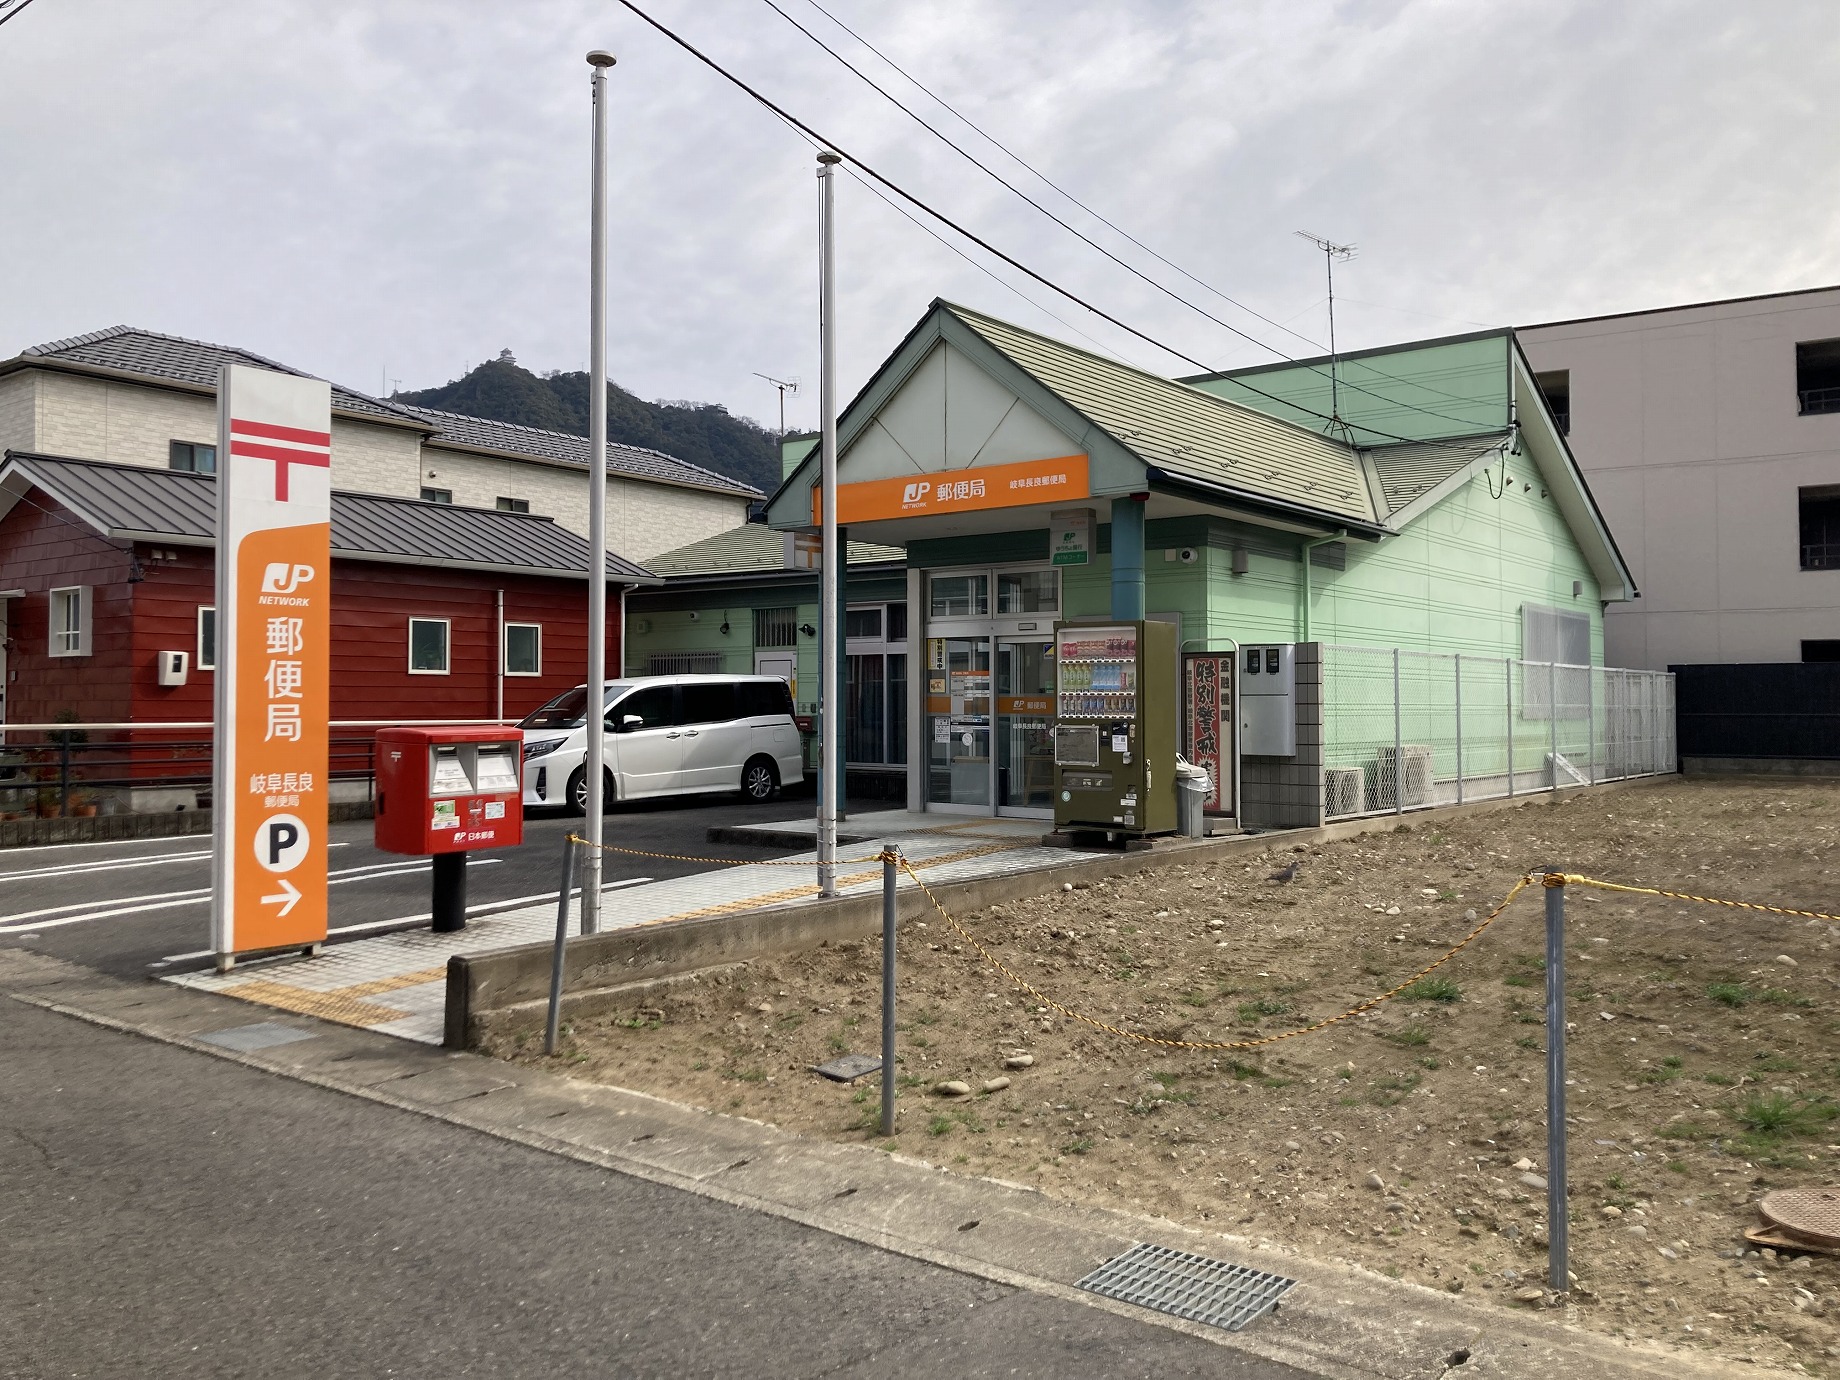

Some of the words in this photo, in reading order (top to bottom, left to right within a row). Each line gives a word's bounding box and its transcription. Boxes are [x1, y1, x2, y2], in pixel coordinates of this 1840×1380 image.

[936, 479, 986, 502] 郵便局
[1009, 474, 1067, 490] 岐阜長良郵便局
[901, 502, 927, 510] NETWORK
[258, 595, 310, 607] NETWORK
[264, 616, 304, 743] 郵便局
[1220, 659, 1230, 722] 金融機関
[249, 772, 314, 794] 岐阜長良
[264, 795, 300, 808] 郵便局
[269, 822, 298, 865] P
[468, 830, 495, 841] 日本郵便
